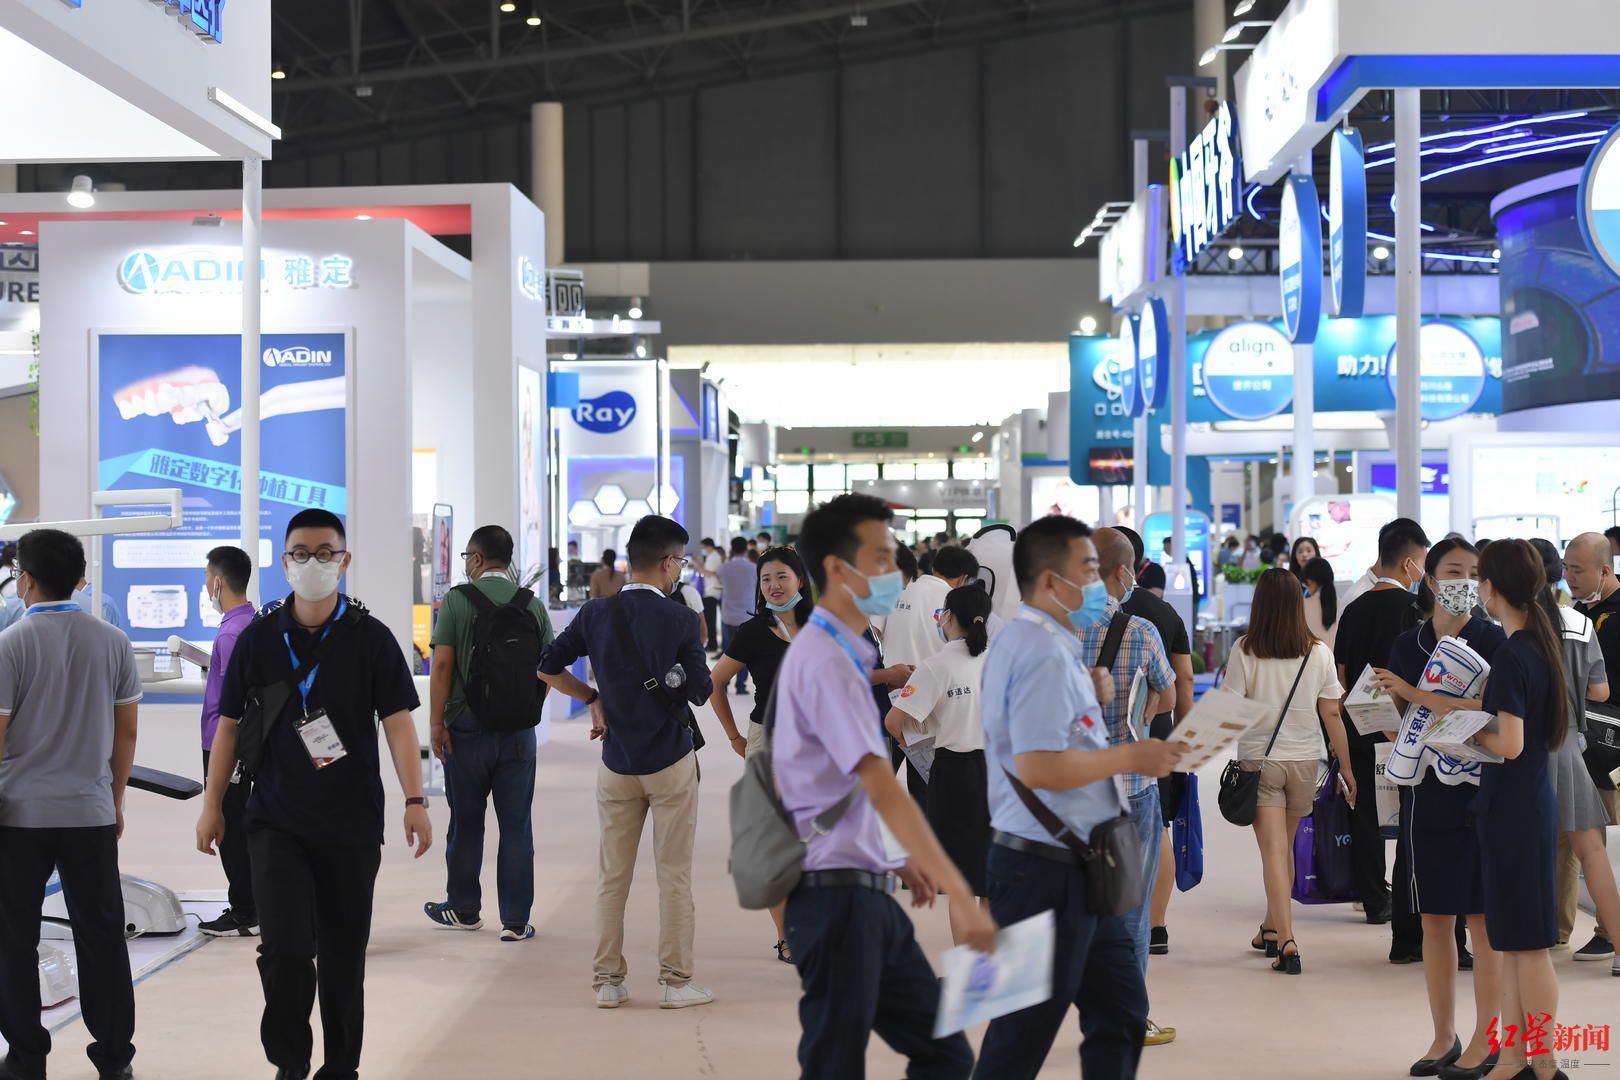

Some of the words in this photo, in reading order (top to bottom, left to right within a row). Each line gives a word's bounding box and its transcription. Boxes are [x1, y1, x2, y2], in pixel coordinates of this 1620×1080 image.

[284, 257, 350, 286] 雅定
[0, 281, 39, 302] RE
[281, 351, 332, 363] ADIN
[1229, 338, 1274, 357] align
[577, 403, 634, 427] Ray
[1403, 705, 1432, 746] 舒适达
